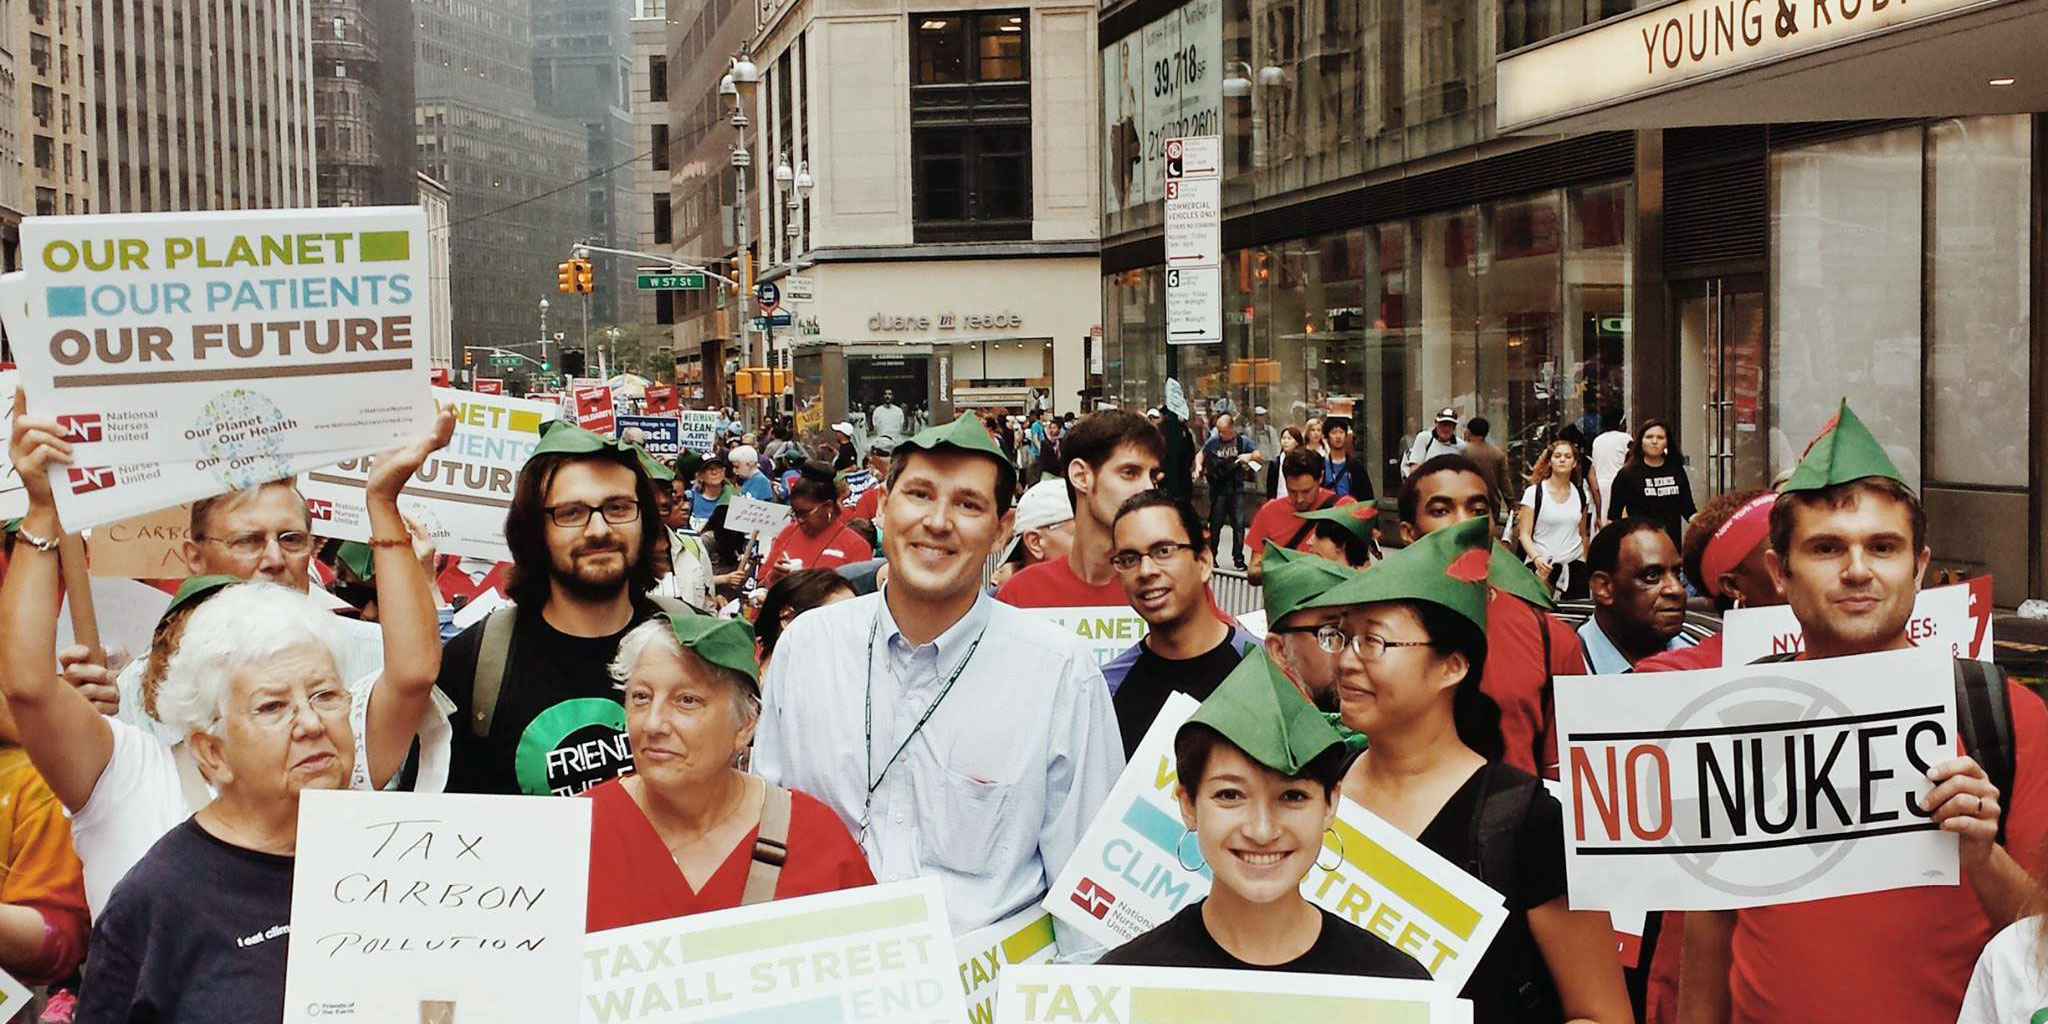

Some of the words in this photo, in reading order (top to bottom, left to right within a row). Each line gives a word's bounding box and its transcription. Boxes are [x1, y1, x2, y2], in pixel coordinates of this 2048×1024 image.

[1642, 0, 1762, 74] YOUNG
[1775, 0, 1798, 38] &
[1154, 44, 1196, 97] 39,718
[1168, 183, 1177, 199] 3
[1168, 202, 1210, 211] COMMERCIAL
[1168, 211, 1198, 220] VEHICLES
[1200, 210, 1216, 218] ONLY
[42, 238, 149, 273] OUR
[165, 232, 353, 269] PLANET
[650, 278, 660, 287] W
[662, 278, 677, 287] 57
[680, 277, 691, 287] St
[1169, 271, 1178, 287] 6
[91, 282, 191, 317] OUR
[206, 274, 413, 313] PATIENTS
[869, 312, 930, 331] duane
[963, 310, 1022, 330] reade
[50, 325, 174, 366] OUR
[192, 316, 412, 360] FUTURE
[106, 411, 158, 421] National
[107, 422, 149, 432] Nurses
[184, 428, 211, 440] Our
[216, 415, 262, 434] Planet
[108, 432, 149, 443] United
[219, 432, 245, 444] Our
[250, 419, 297, 438] Health
[645, 428, 671, 440] ach
[646, 443, 678, 452] nce
[121, 471, 160, 485] United
[416, 458, 519, 494] UTUR
[335, 510, 359, 519] Nurses
[335, 517, 359, 527] United
[1058, 618, 1145, 639] ANET
[1907, 617, 1937, 639] ES:
[545, 732, 634, 779] FRIEND
[1569, 744, 1672, 842] NO
[1696, 720, 1947, 839] NUKES
[366, 820, 483, 862] TAX
[1102, 838, 1196, 912] CLIM
[335, 873, 545, 911] CARBON
[1117, 901, 1156, 932] Nationa
[1304, 865, 1458, 975] TREET
[1106, 919, 1132, 940] Unite
[316, 932, 546, 958] POLLUTION
[584, 936, 675, 982] TAX
[959, 945, 1000, 995] TAX
[587, 972, 733, 1024] WALL
[751, 934, 933, 994] STREET
[853, 978, 945, 1021] END
[1016, 984, 1122, 1024] TAX
